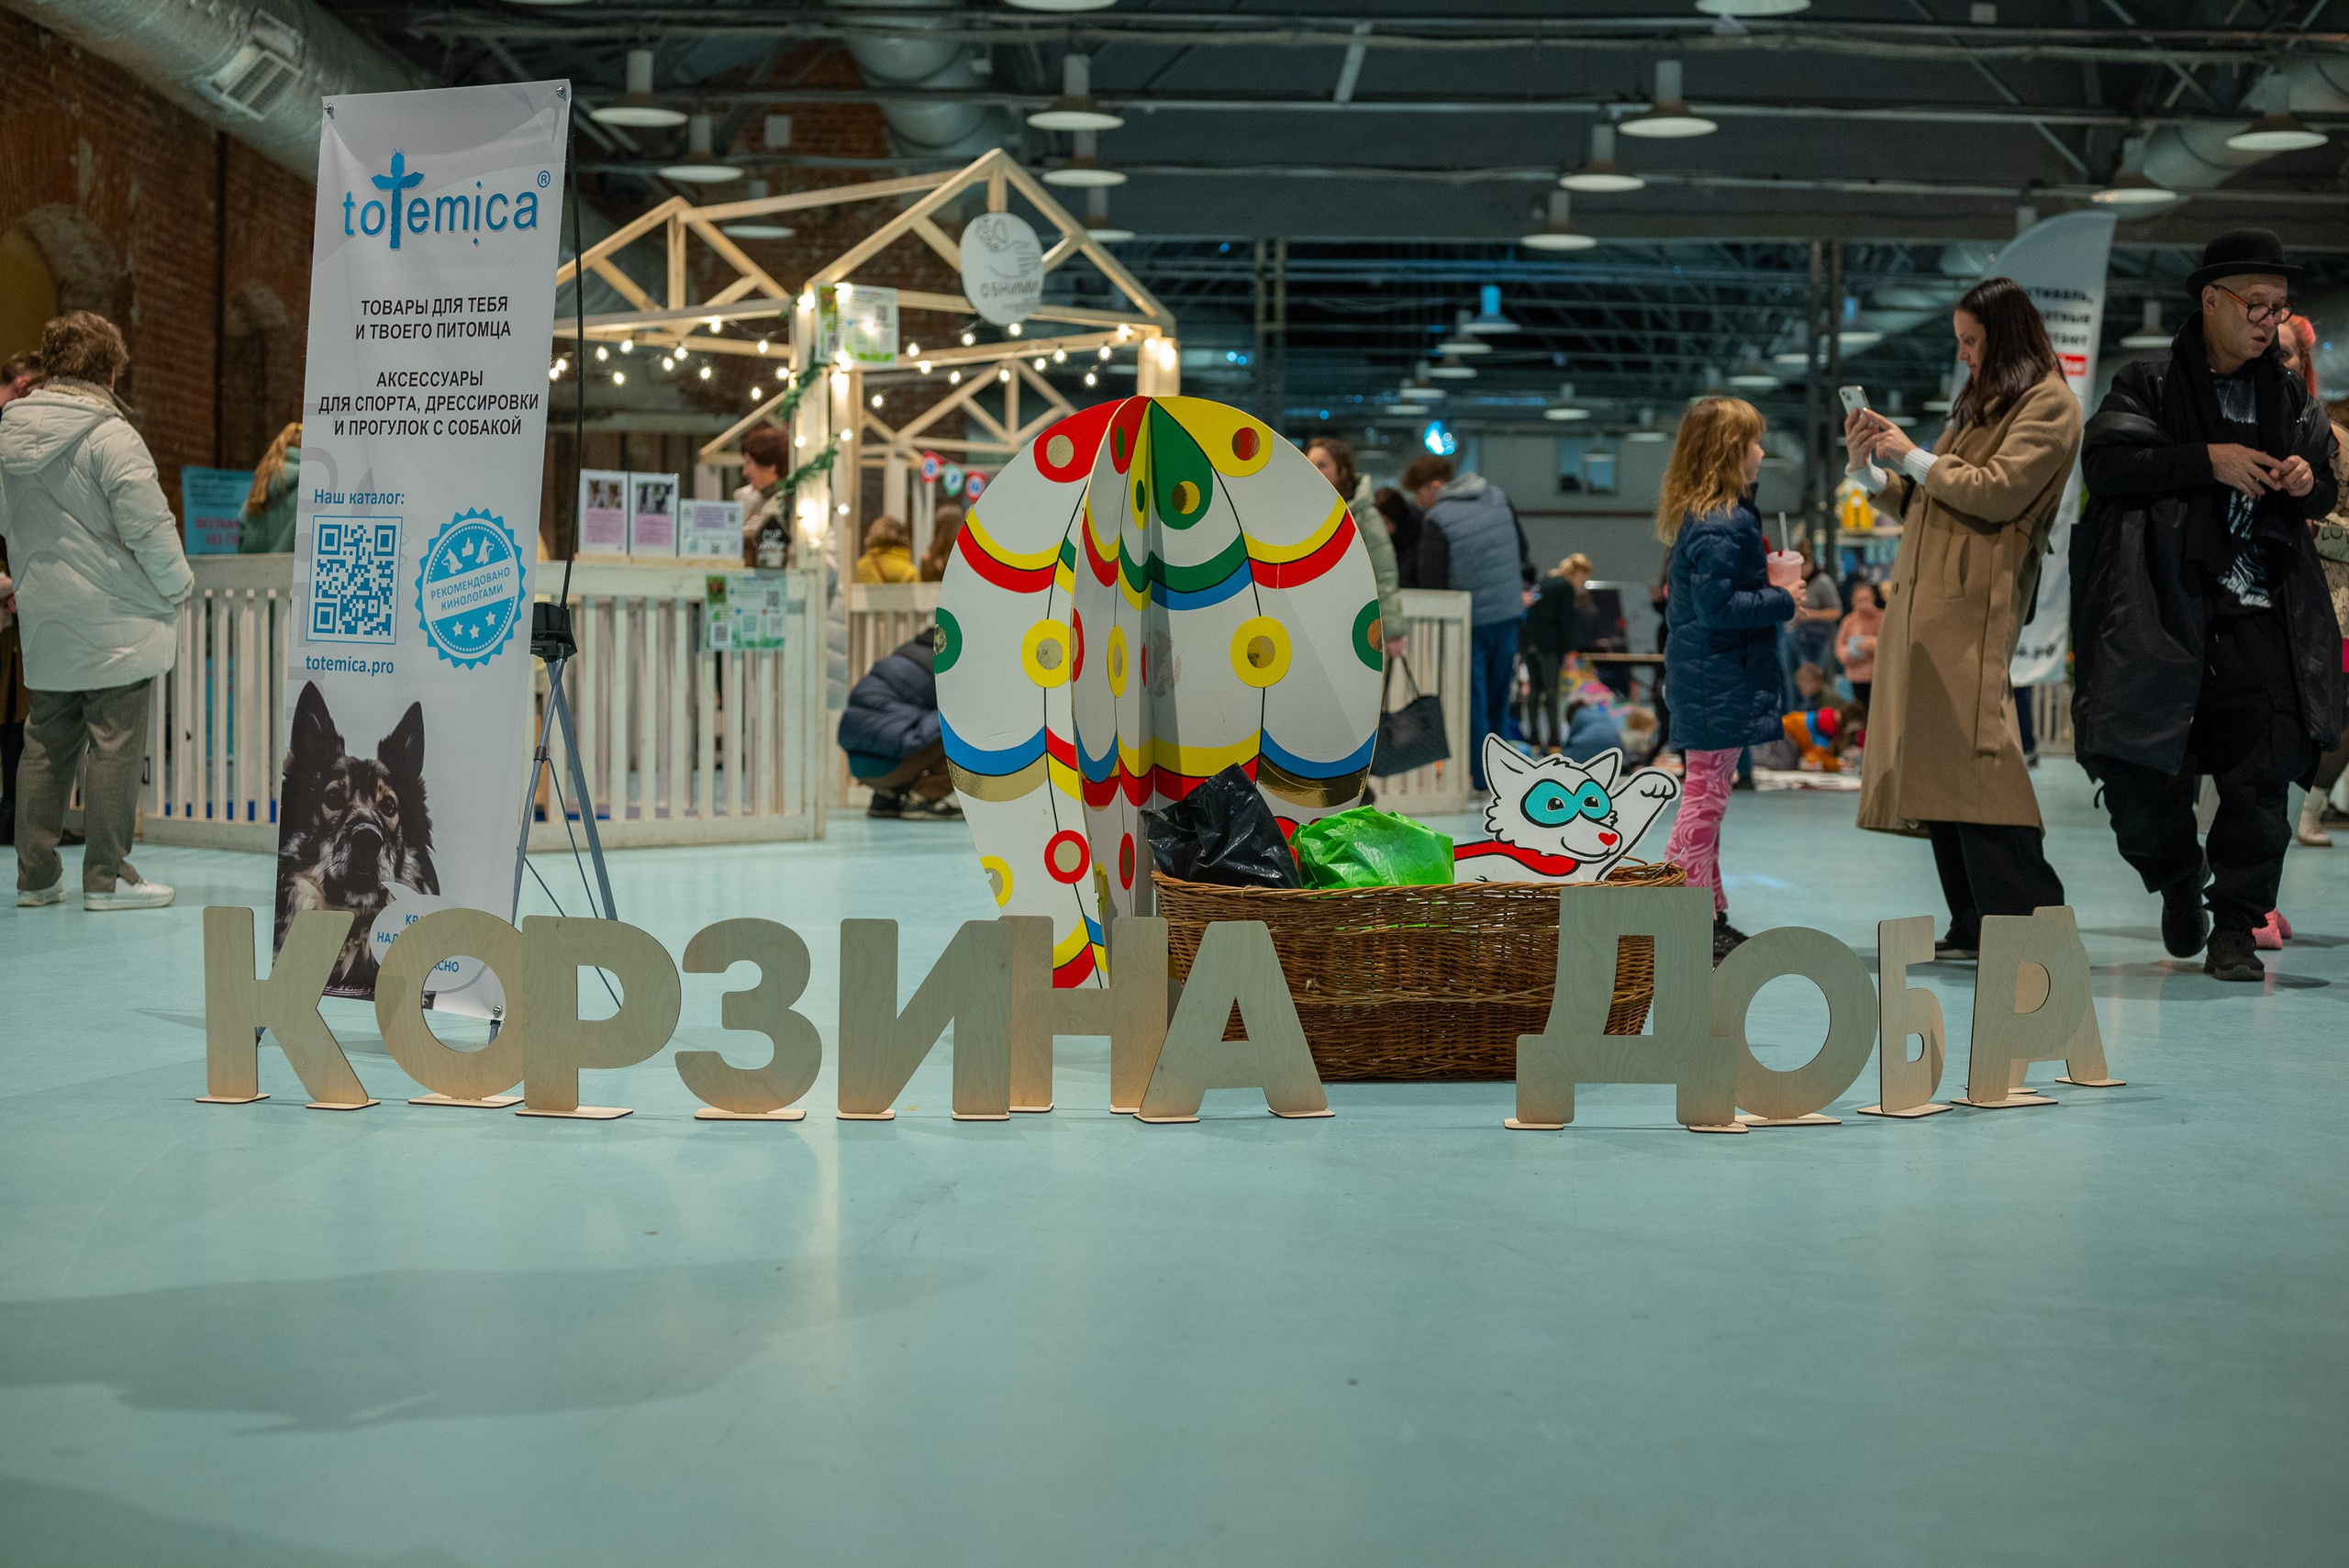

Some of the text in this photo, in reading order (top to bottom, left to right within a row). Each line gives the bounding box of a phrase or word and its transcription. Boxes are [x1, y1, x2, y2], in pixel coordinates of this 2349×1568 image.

[361, 295, 508, 317] ТОВАРЫ ДЛЯ ТЕБЯ
[355, 320, 511, 340] И ТВОЕГО ПИТОМЦА
[375, 370, 484, 388] АКСЕССУАРЫ
[317, 393, 540, 416] ДЛЯ СПОРТА, ДРЕССИРОВКИ
[333, 416, 523, 437] И ПРОГУЛОК С СОБАКОЙ
[313, 488, 405, 506] Наш каталог:
[429, 566, 511, 601] РЕКОМЕНДОВАНО
[440, 584, 504, 612] КИНОЛОГАМИ
[305, 654, 395, 677] totemica.pro
[204, 906, 1328, 1117] КОРЗИНА
